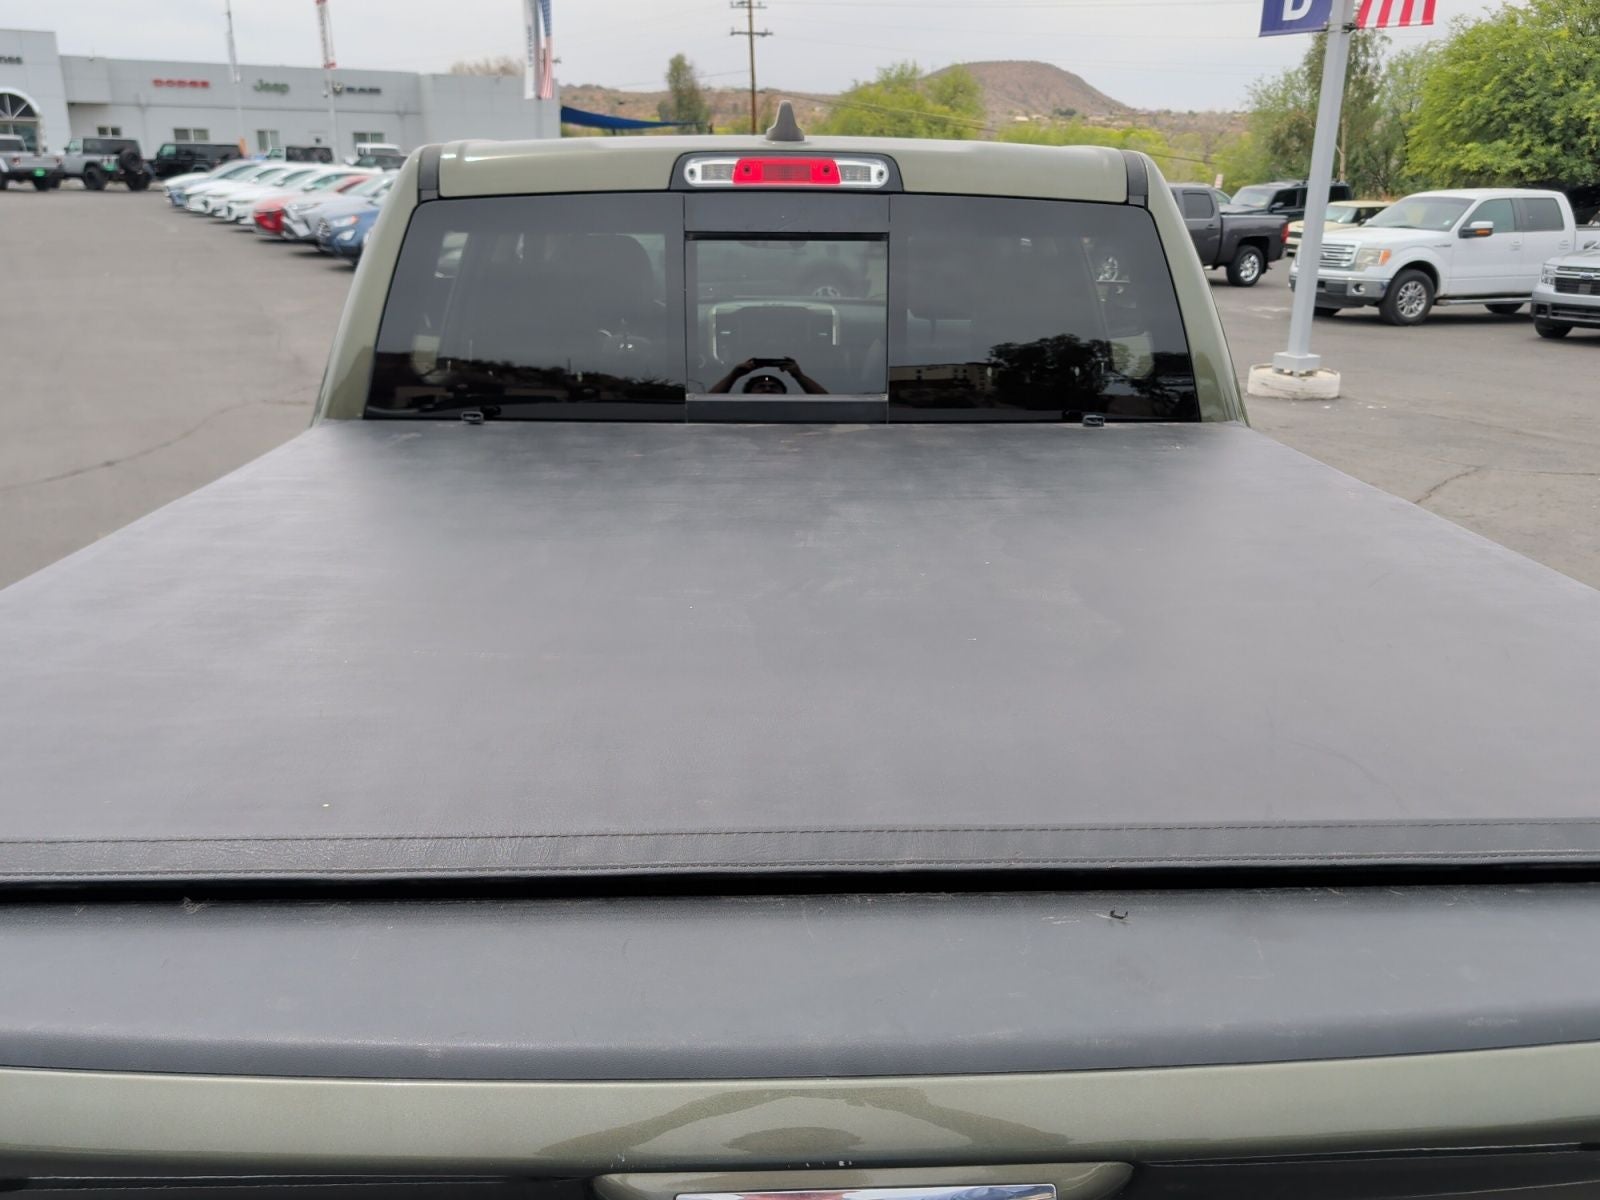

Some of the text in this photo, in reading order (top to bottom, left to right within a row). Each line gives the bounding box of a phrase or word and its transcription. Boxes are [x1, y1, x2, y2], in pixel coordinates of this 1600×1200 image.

[152, 79, 209, 88] DODGE
[254, 79, 289, 93] Jeep
[345, 86, 382, 95] RAM
